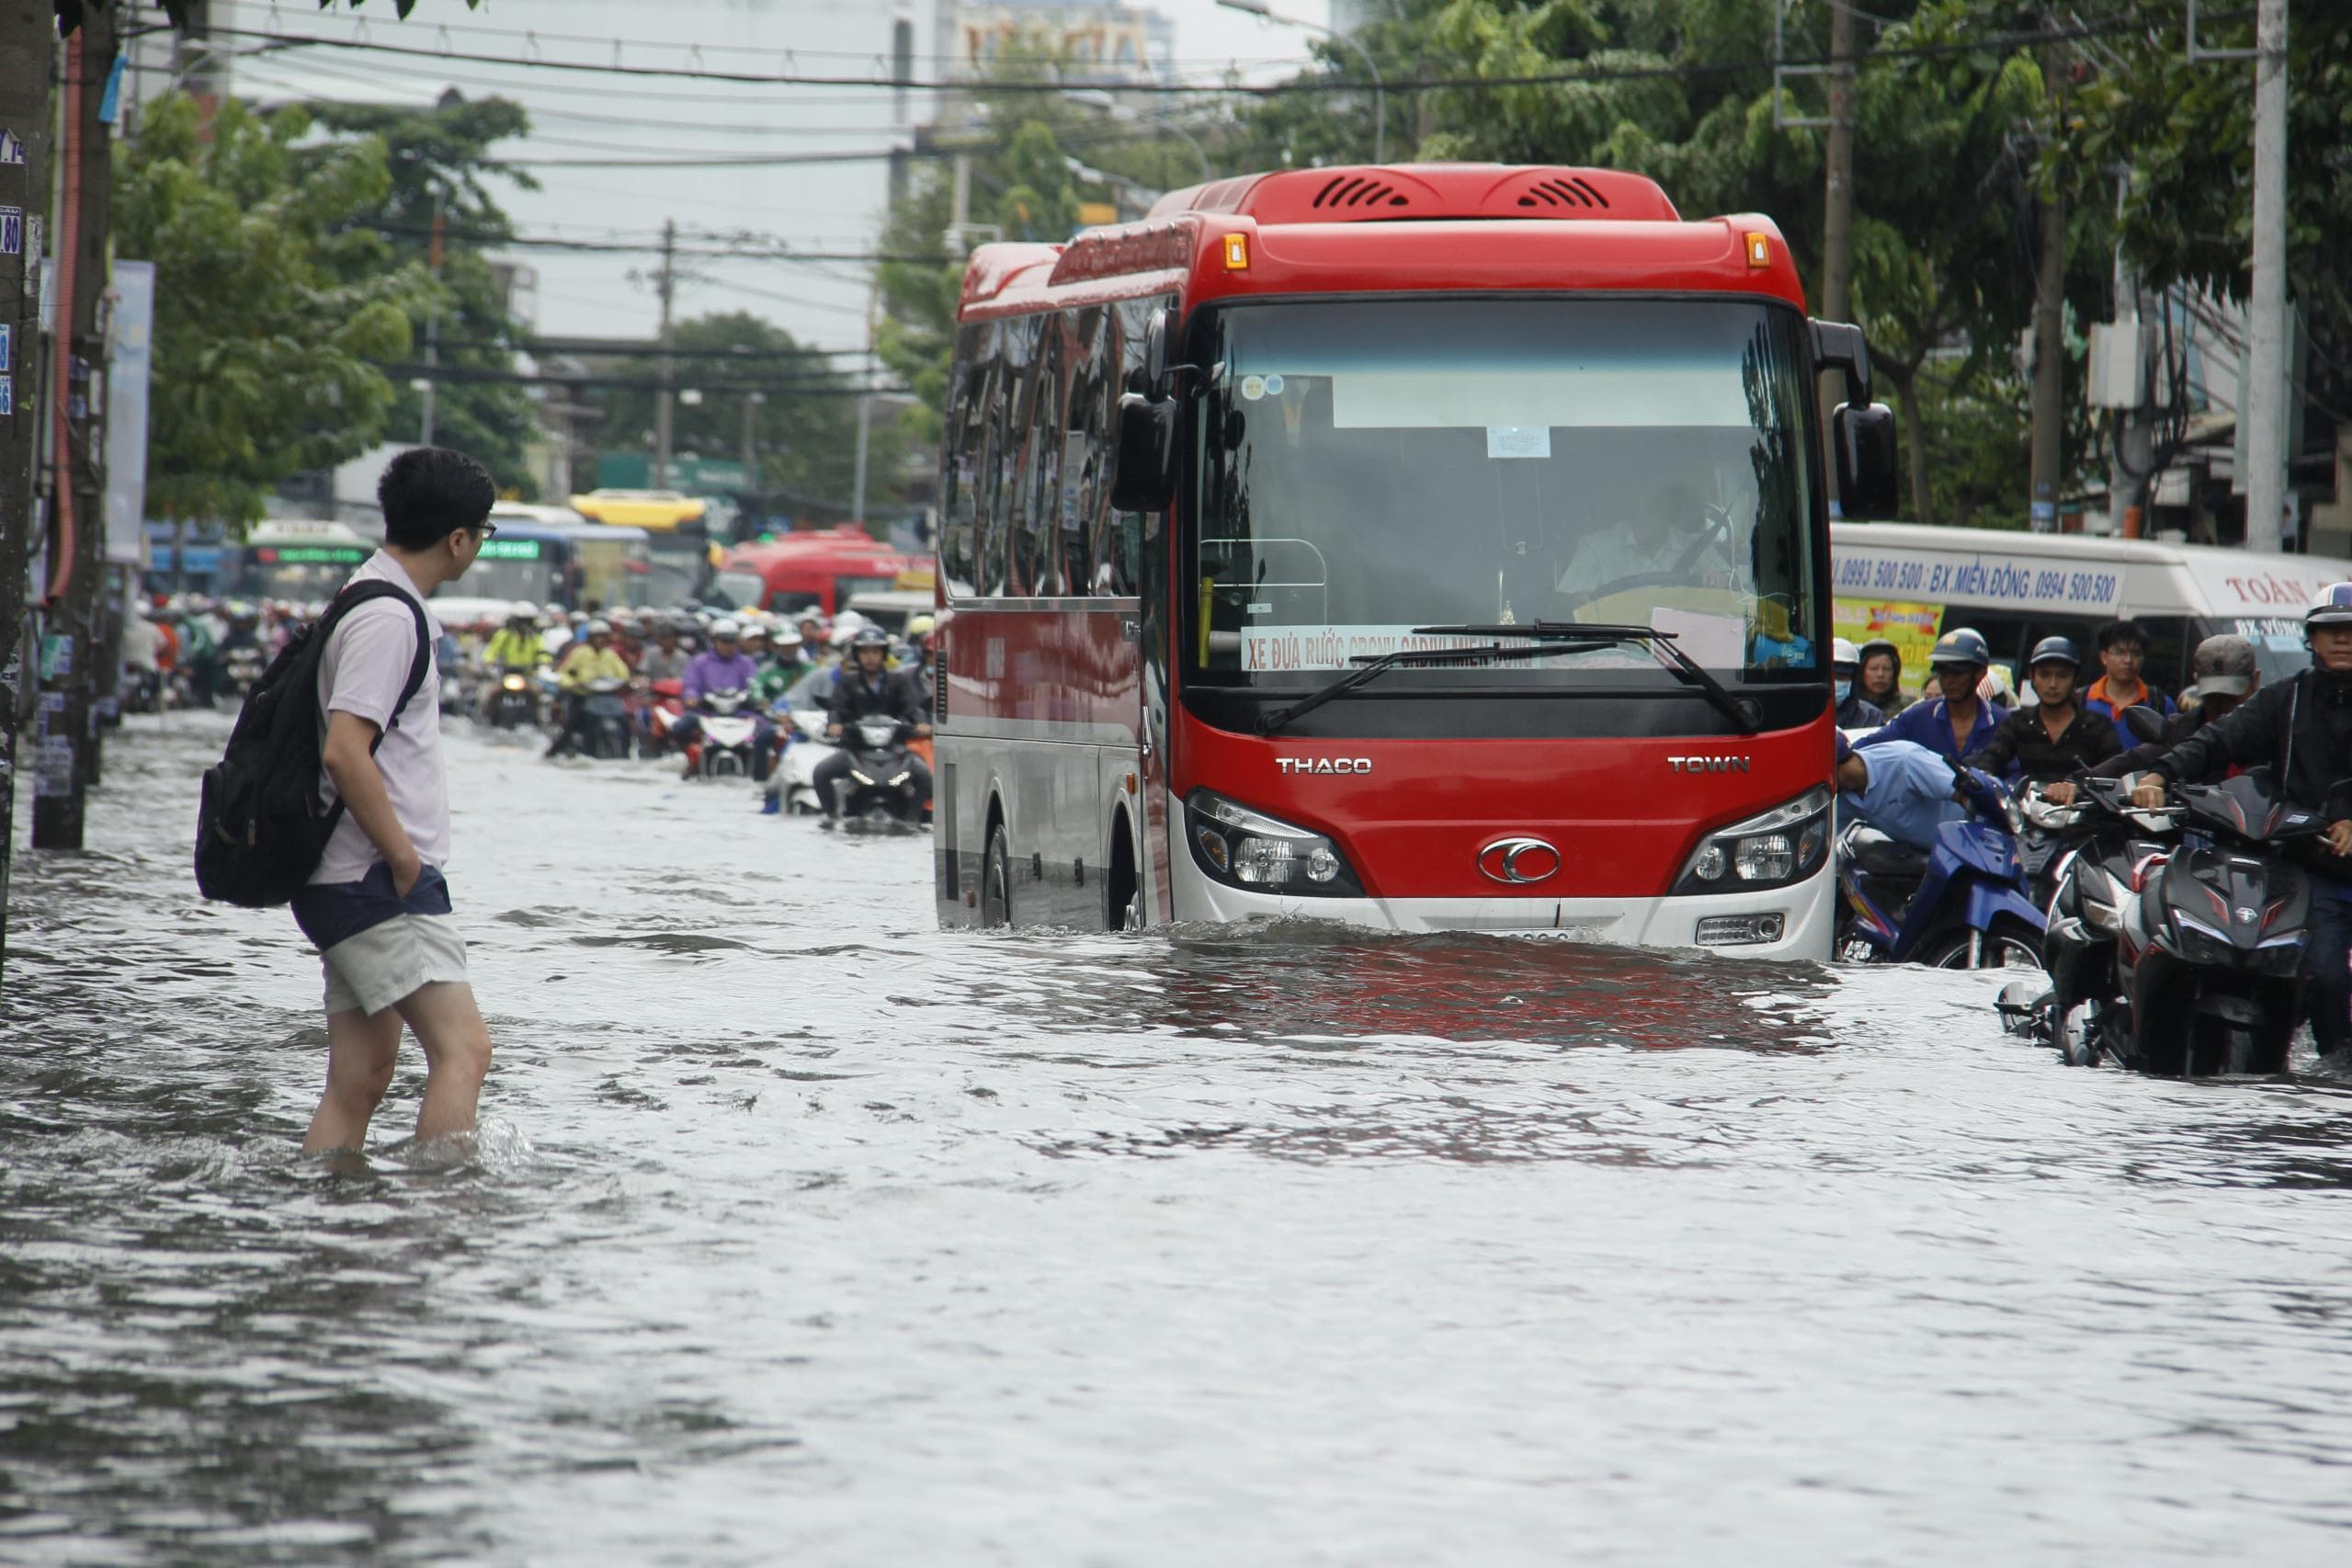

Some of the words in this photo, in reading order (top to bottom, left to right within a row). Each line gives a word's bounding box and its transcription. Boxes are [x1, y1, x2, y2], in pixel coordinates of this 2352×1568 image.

[1874, 560, 1898, 588] 500
[1898, 562, 1924, 589] 500
[2068, 573, 2093, 600] 500
[2092, 574, 2117, 603] 500
[2225, 572, 2311, 606] TOÀN
[1248, 638, 1267, 669] XE
[1271, 631, 1301, 669] ĐƯA
[1276, 758, 1371, 773] THACO
[1667, 756, 1750, 773] TOWN
